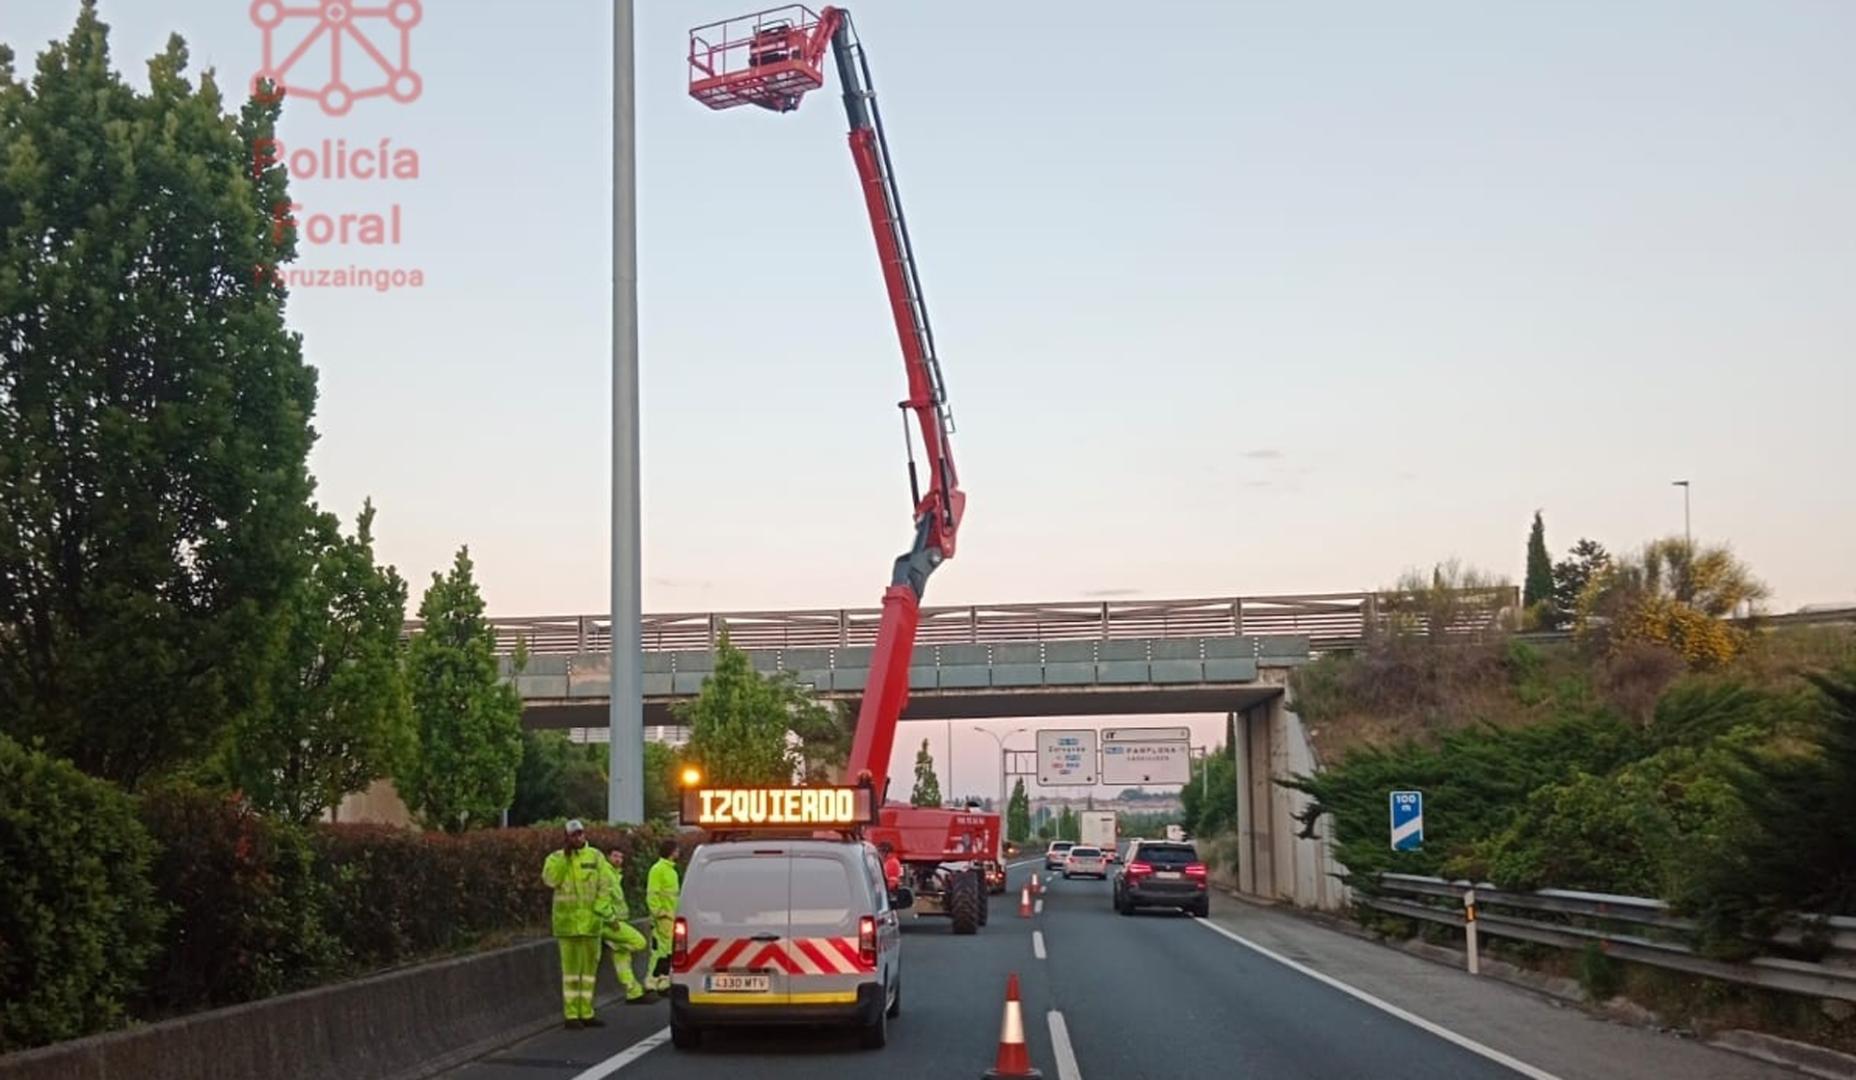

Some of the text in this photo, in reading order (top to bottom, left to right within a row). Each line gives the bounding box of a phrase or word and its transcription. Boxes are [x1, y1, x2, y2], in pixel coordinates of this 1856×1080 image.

[1396, 795, 1416, 803] 100
[699, 789, 854, 823] IZQUIERDO
[745, 978, 766, 987] MTV
